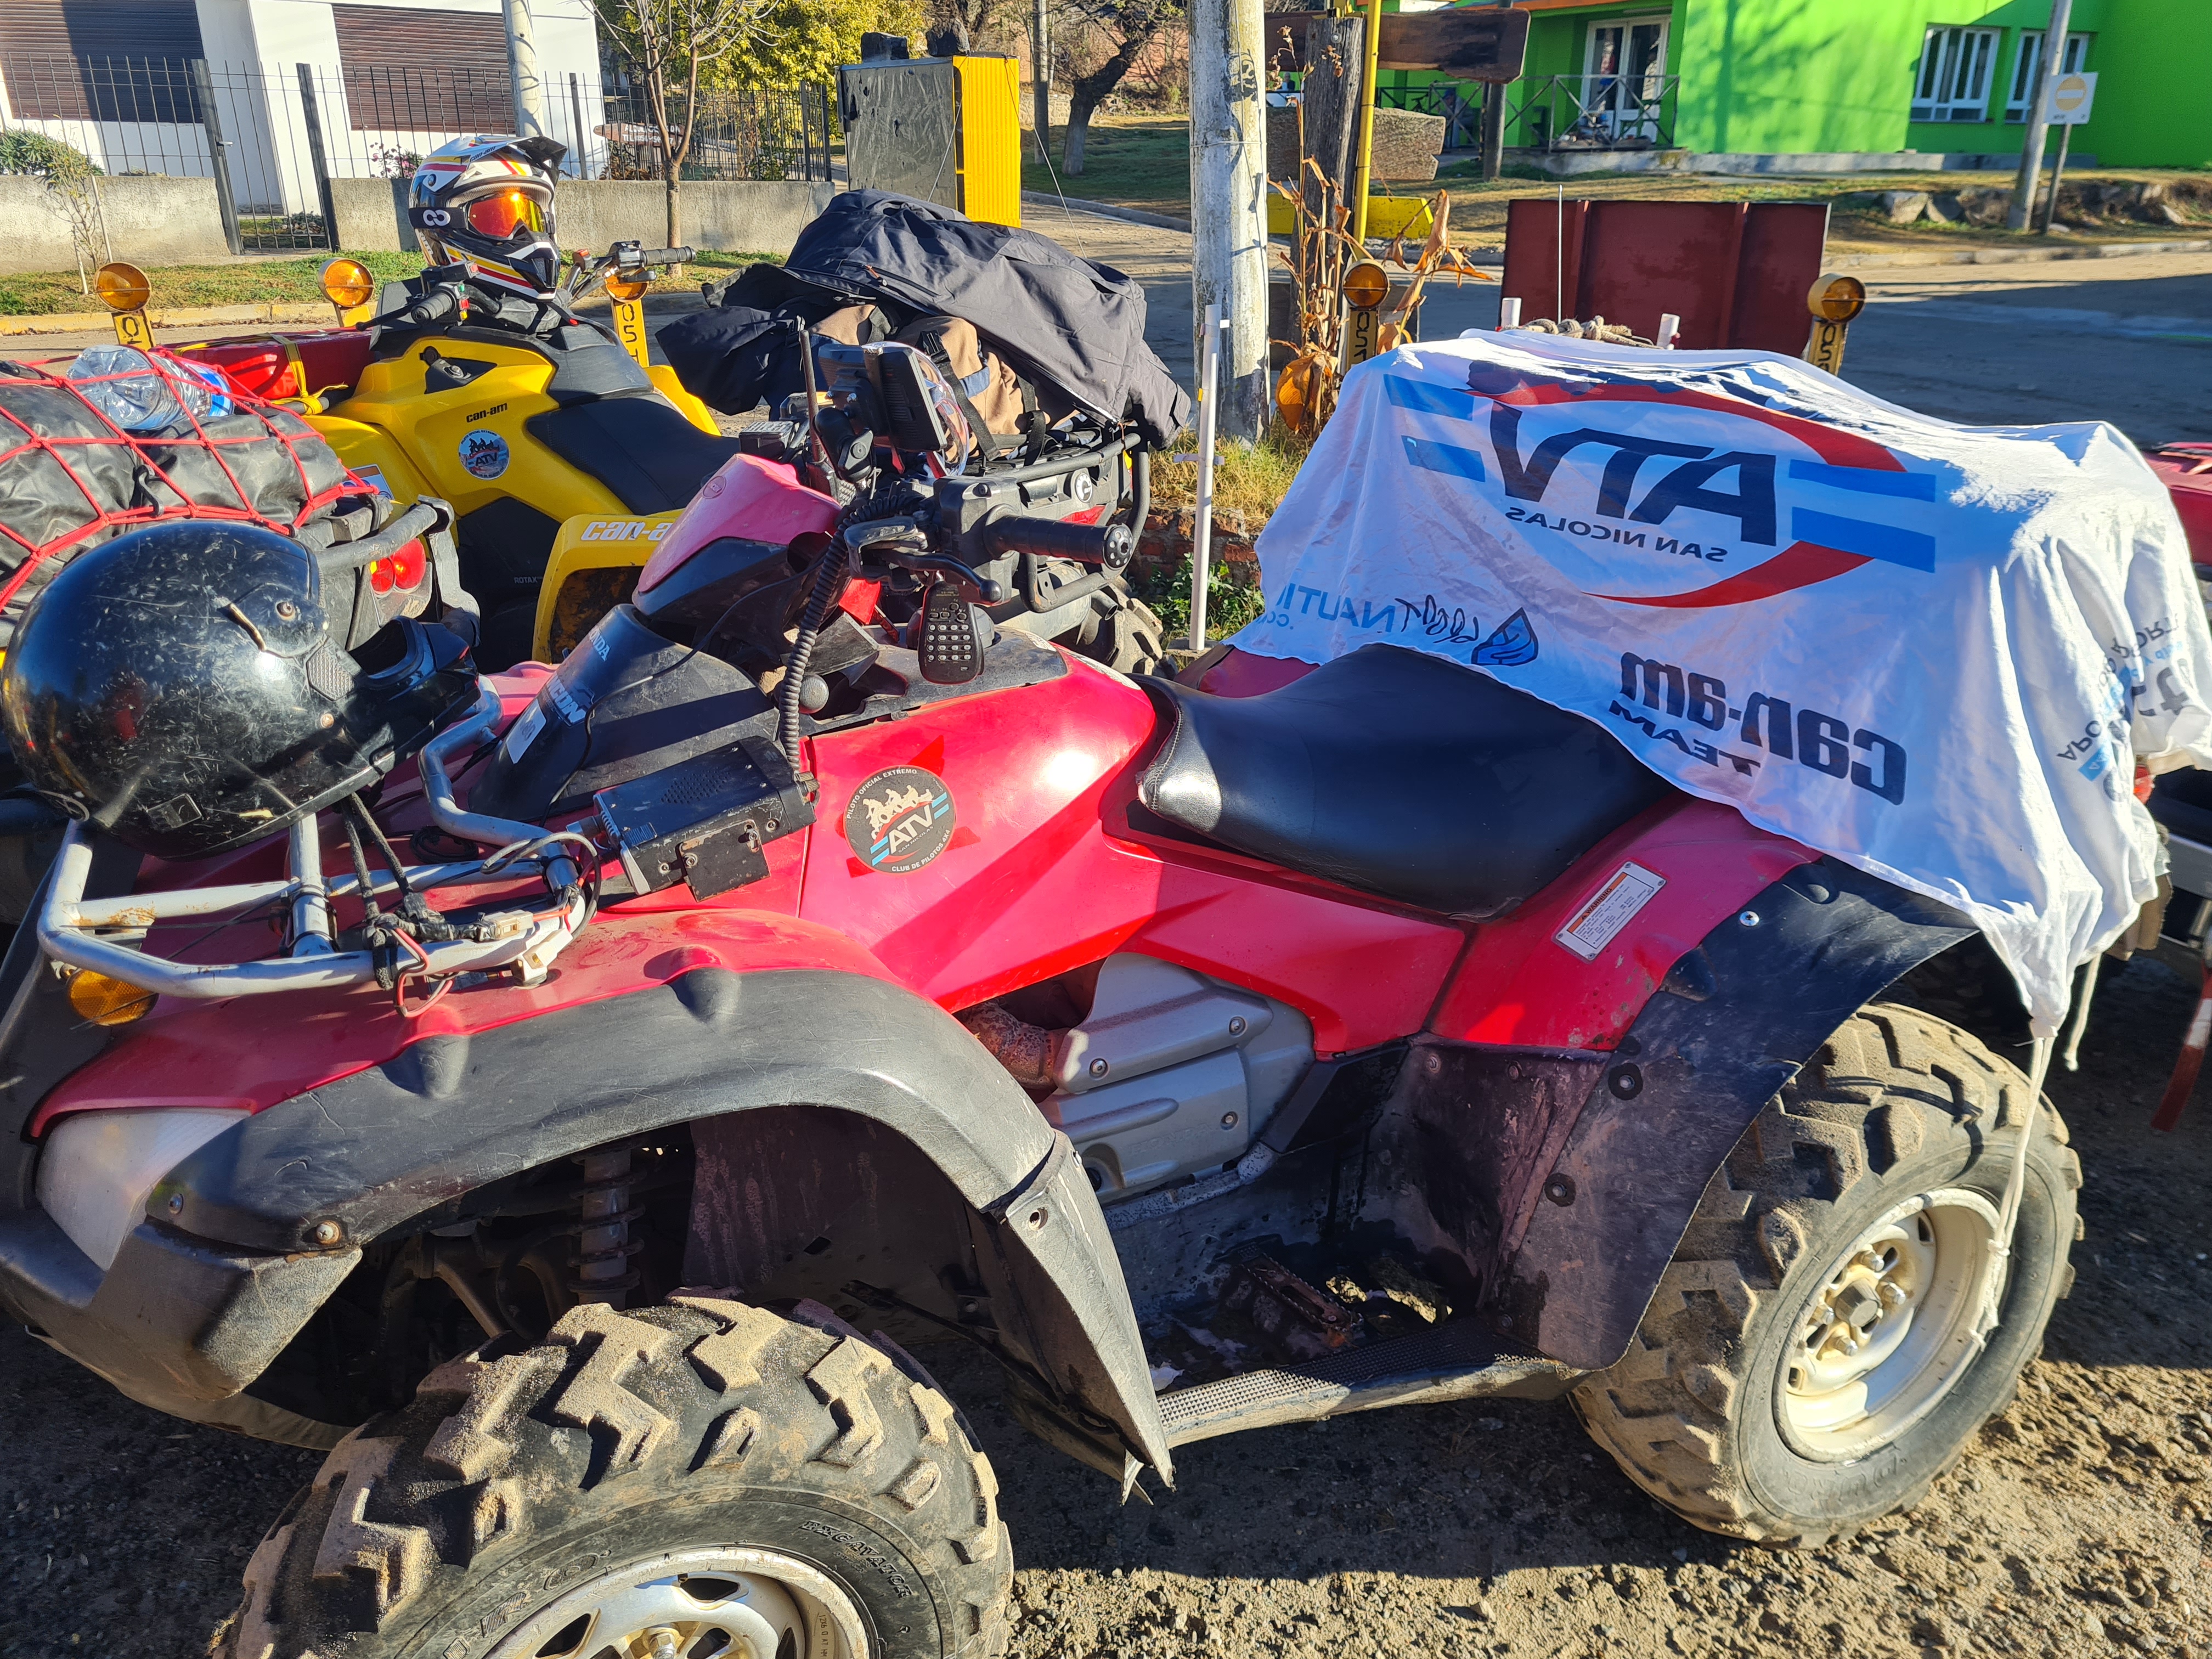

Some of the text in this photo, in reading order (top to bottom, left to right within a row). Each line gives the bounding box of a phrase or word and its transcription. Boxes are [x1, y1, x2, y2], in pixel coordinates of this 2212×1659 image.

[466, 403, 508, 423] can-am
[475, 452, 498, 466] ATV
[580, 522, 674, 540] can-a
[589, 625, 611, 662] ONDA
[847, 769, 917, 820] PILOTO OFICIAL EXTREMO
[889, 804, 933, 854] ATV
[898, 826, 934, 853] SAN NICOLAS
[921, 842, 944, 865] PILOTOS
[1585, 888, 1612, 914] WARNING
[799, 1520, 913, 1599] EXCAVATOR
